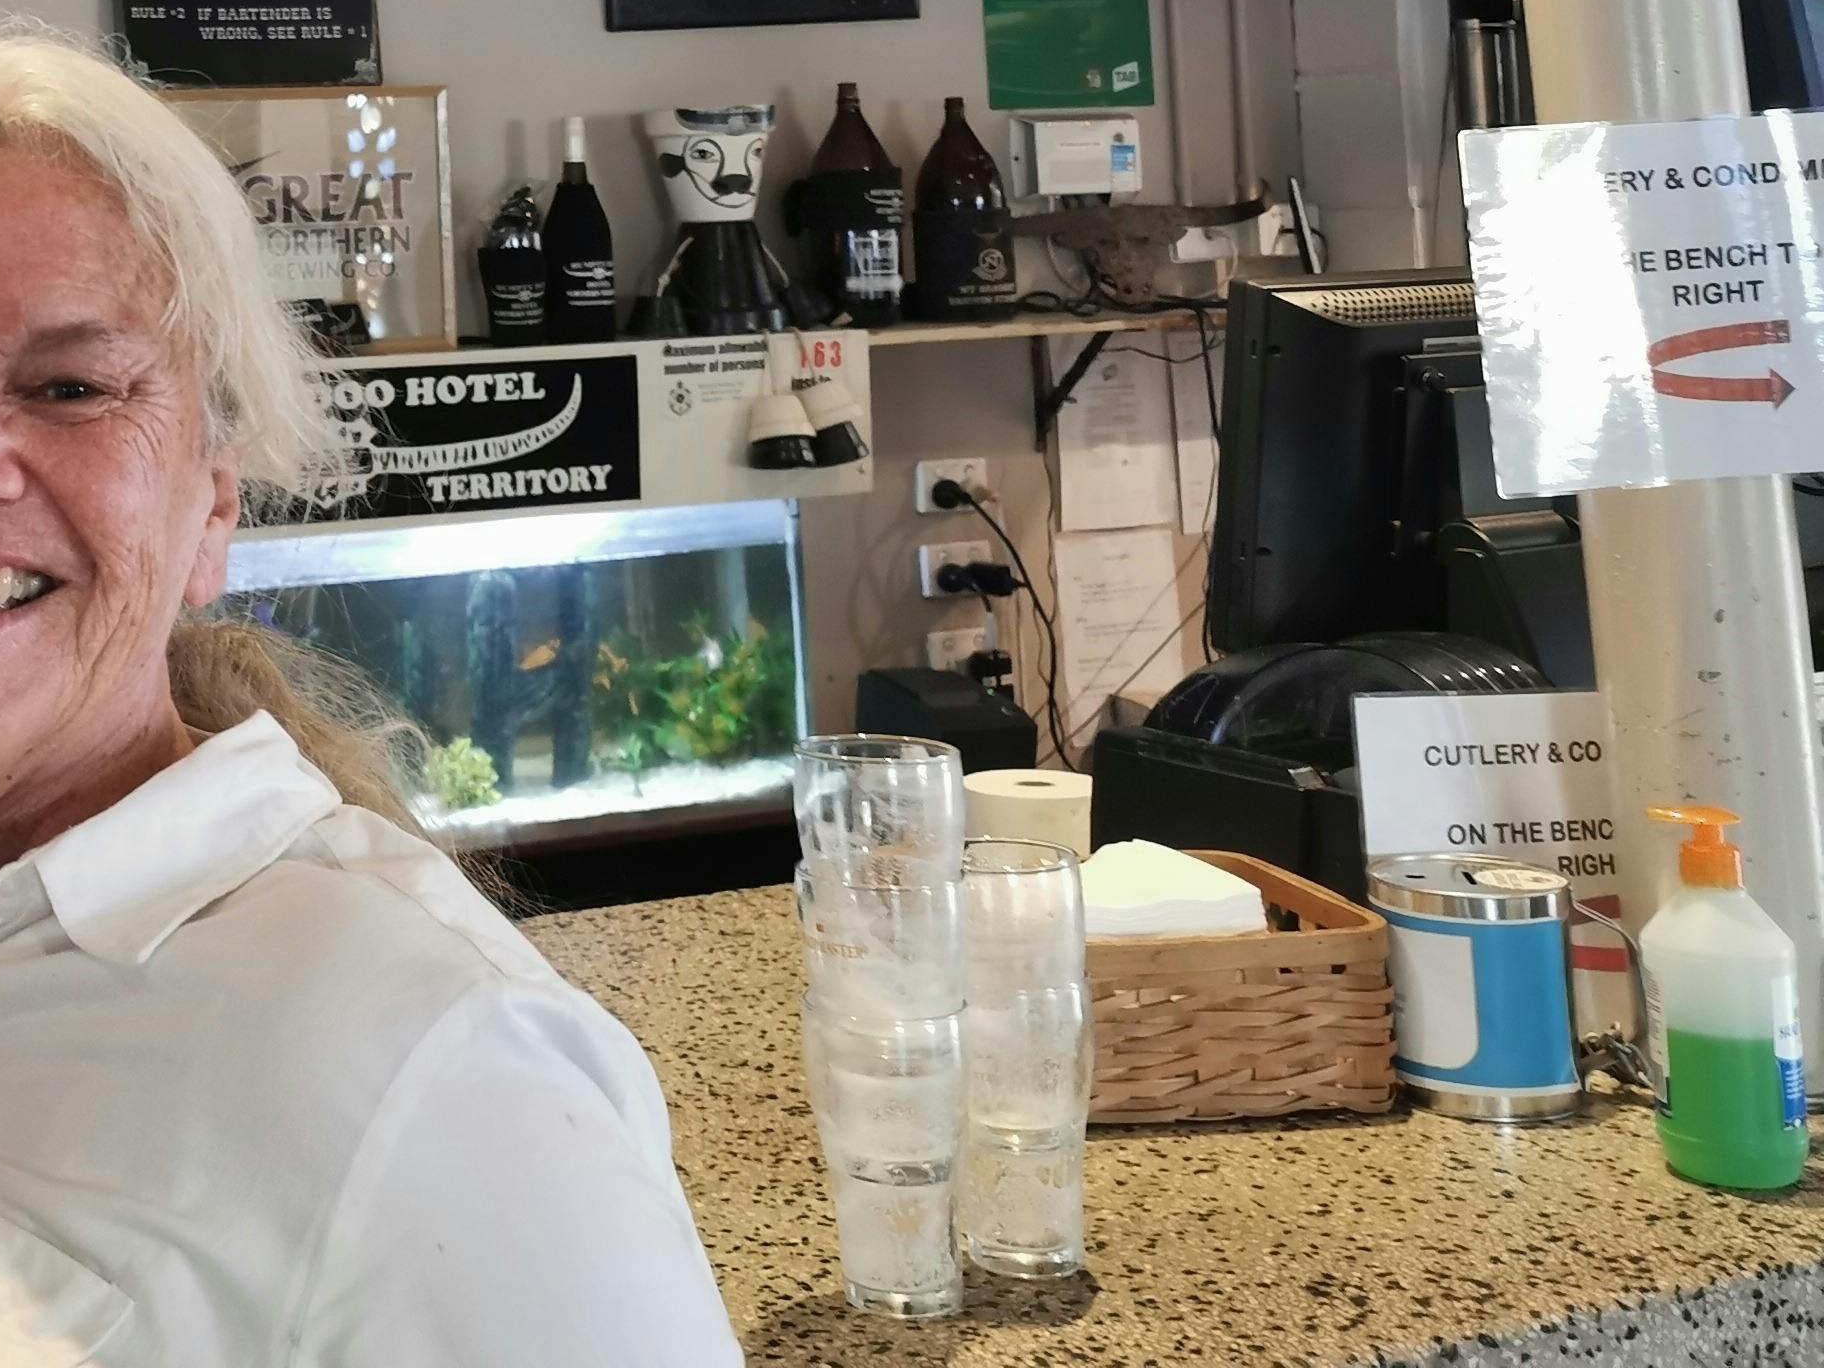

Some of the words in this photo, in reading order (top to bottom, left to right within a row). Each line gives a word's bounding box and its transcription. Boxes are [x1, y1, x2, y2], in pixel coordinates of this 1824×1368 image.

[131, 7, 166, 19] RULE
[197, 7, 212, 20] IF
[217, 7, 312, 21] BARTENDER
[316, 7, 332, 20] IS
[267, 27, 296, 40] SEE
[300, 26, 343, 39] RULE
[1665, 168, 1685, 190] &
[244, 172, 413, 224] GREAT
[262, 226, 411, 257] ORTHERN
[1665, 243, 1768, 271] BENCH
[1673, 280, 1765, 307] RIGHT
[405, 372, 545, 406] HOTEL
[426, 464, 612, 503] TERRITORY
[1424, 742, 1540, 767] CUTLERY
[1548, 742, 1564, 763] &
[1568, 740, 1602, 763] CO
[1447, 823, 1486, 845] ON
[1493, 821, 1544, 843] THE
[1550, 818, 1614, 842] BENC
[1557, 854, 1616, 878] RIGH
